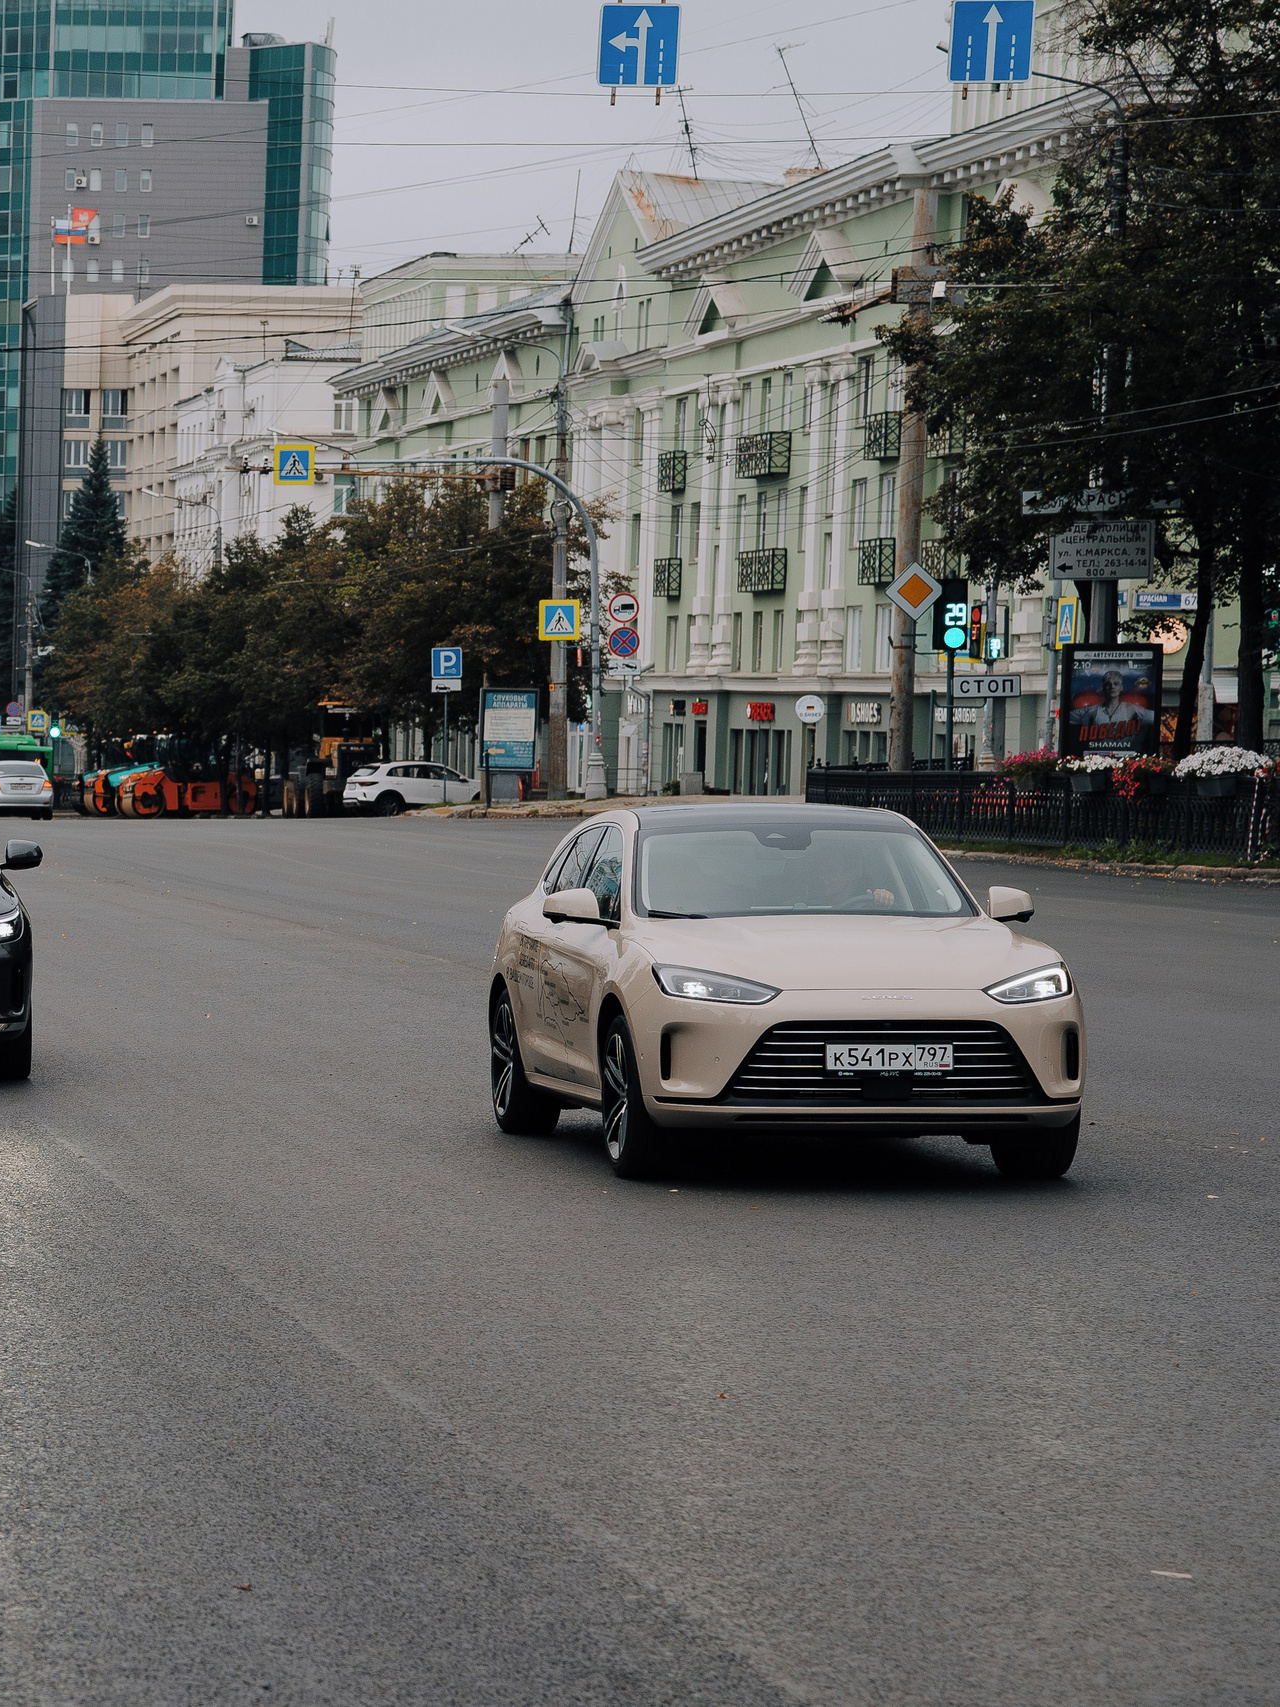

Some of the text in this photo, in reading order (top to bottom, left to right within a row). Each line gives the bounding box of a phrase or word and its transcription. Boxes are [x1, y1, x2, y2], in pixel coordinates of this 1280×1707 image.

[1058, 550, 1071, 558] ул.
[1104, 559, 1147, 568] 263-14-14
[1086, 568, 1105, 577] 800
[1183, 596, 1198, 606] 67
[944, 603, 967, 626] 29
[440, 650, 457, 675] P
[1073, 661, 1092, 669] 2.10
[959, 679, 1014, 694] СТОП
[492, 694, 527, 702] СЛУХОВЫЕ
[492, 701, 528, 709] АППАРАТЫ
[1079, 719, 1143, 741] ПОБЕДА!
[833, 1046, 948, 1067] К541РХ 797
